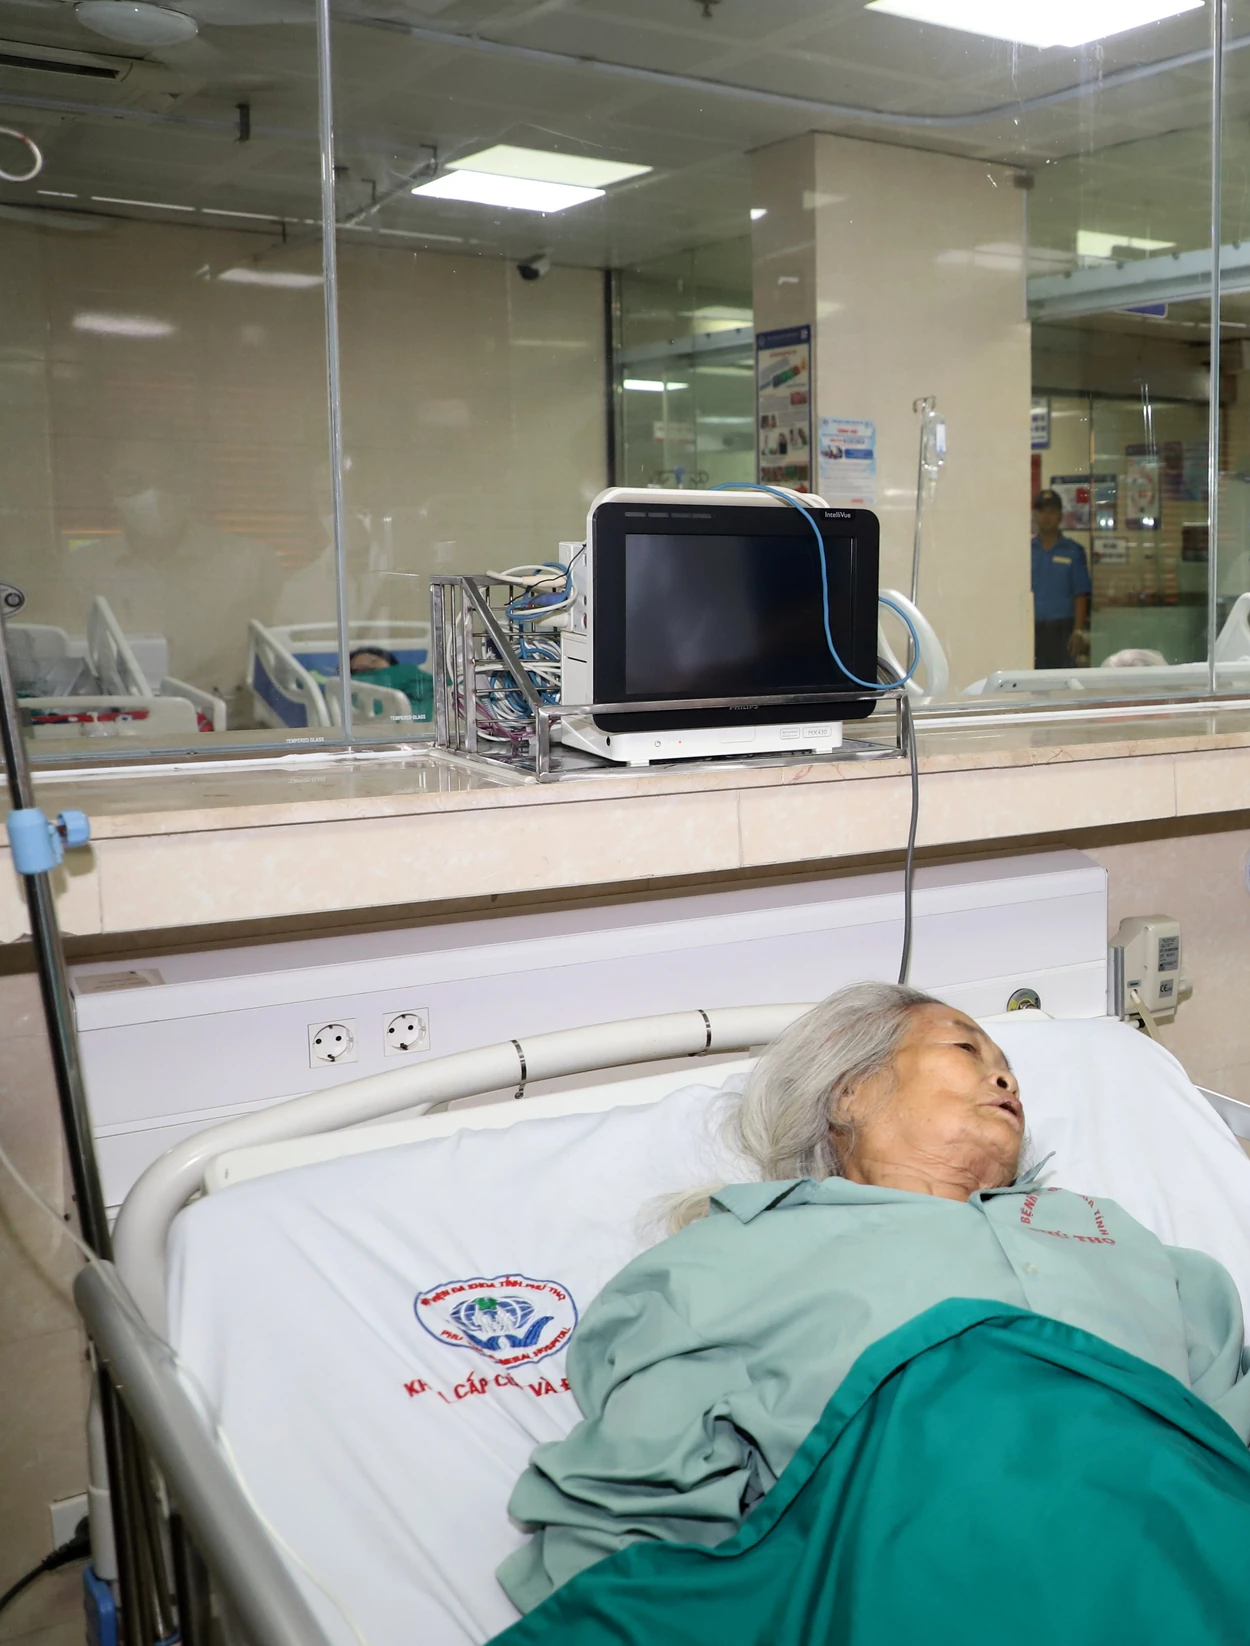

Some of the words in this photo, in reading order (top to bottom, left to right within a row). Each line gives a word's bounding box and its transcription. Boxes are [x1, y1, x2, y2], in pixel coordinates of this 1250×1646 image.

[824, 511, 851, 519] IntelliVue
[499, 1276, 523, 1289] TỈNH
[549, 1285, 567, 1302] THỌ
[453, 1370, 488, 1400] CẤP
[528, 1376, 557, 1397] VÀ
